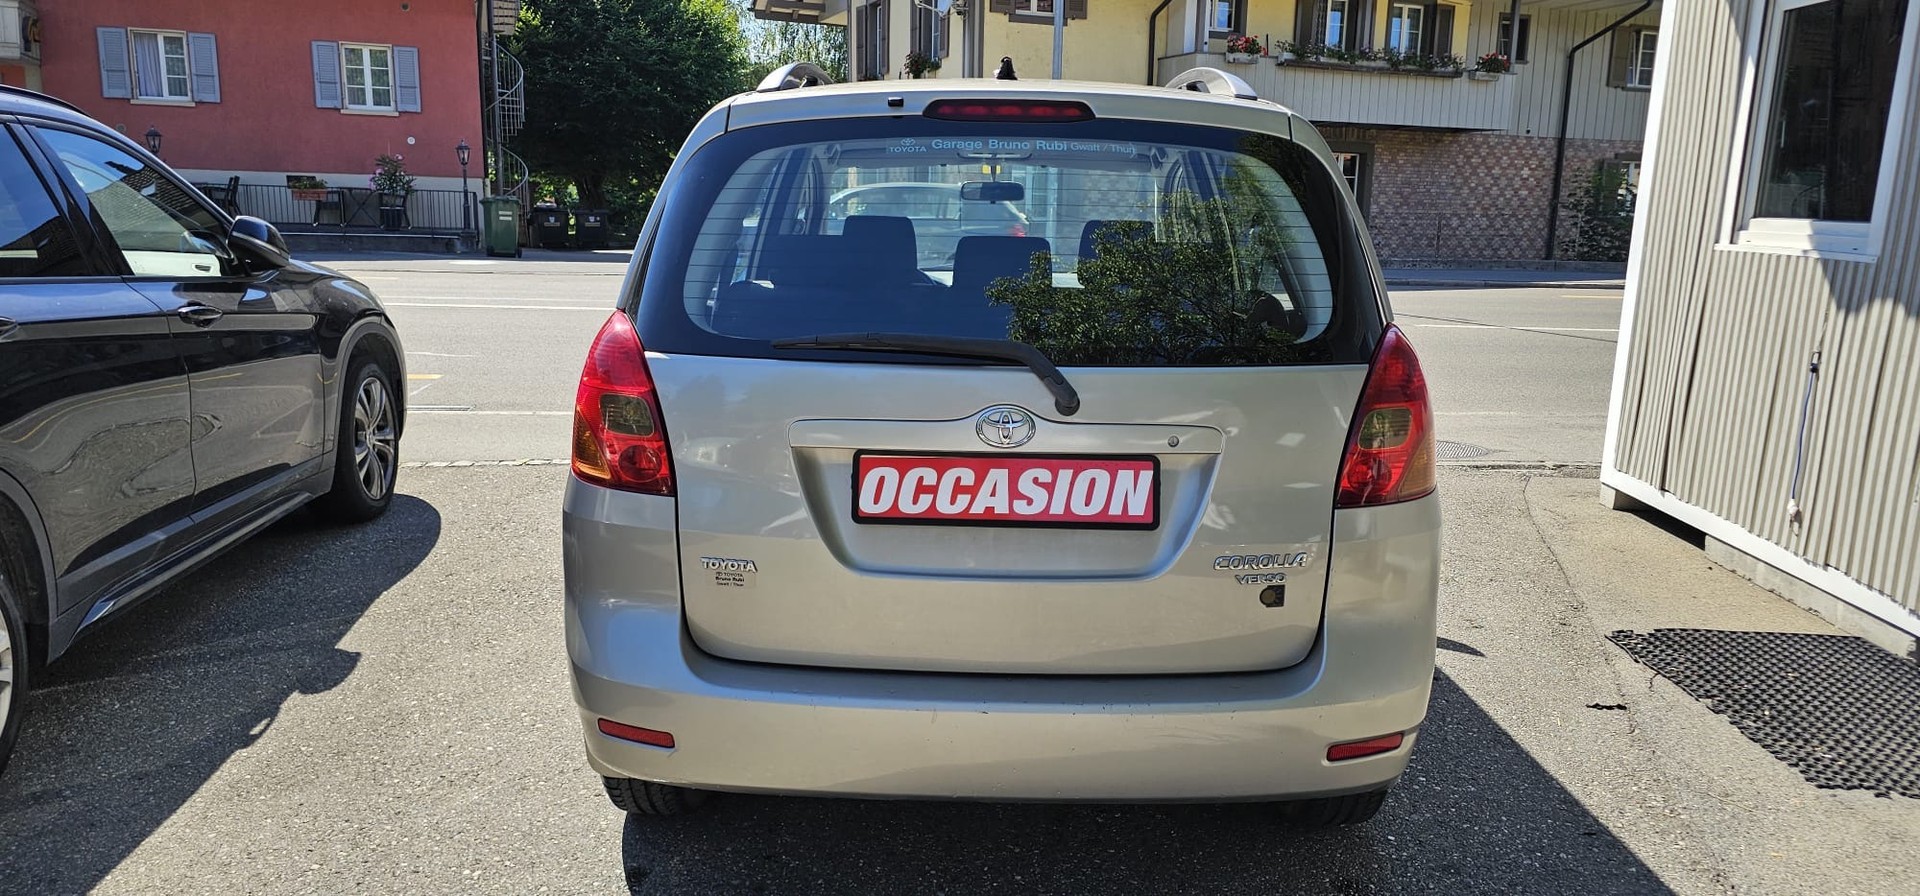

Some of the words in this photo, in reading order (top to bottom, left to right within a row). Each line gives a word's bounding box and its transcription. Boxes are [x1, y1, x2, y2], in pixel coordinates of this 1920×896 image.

[931, 139, 983, 151] Garage
[988, 140, 1030, 150] Bruno
[1036, 140, 1067, 151] Rubi
[858, 466, 1154, 516] OCCASION
[700, 557, 758, 573] TOYOTA
[1214, 552, 1307, 570] COROLLA
[1235, 573, 1286, 584] VERSO
